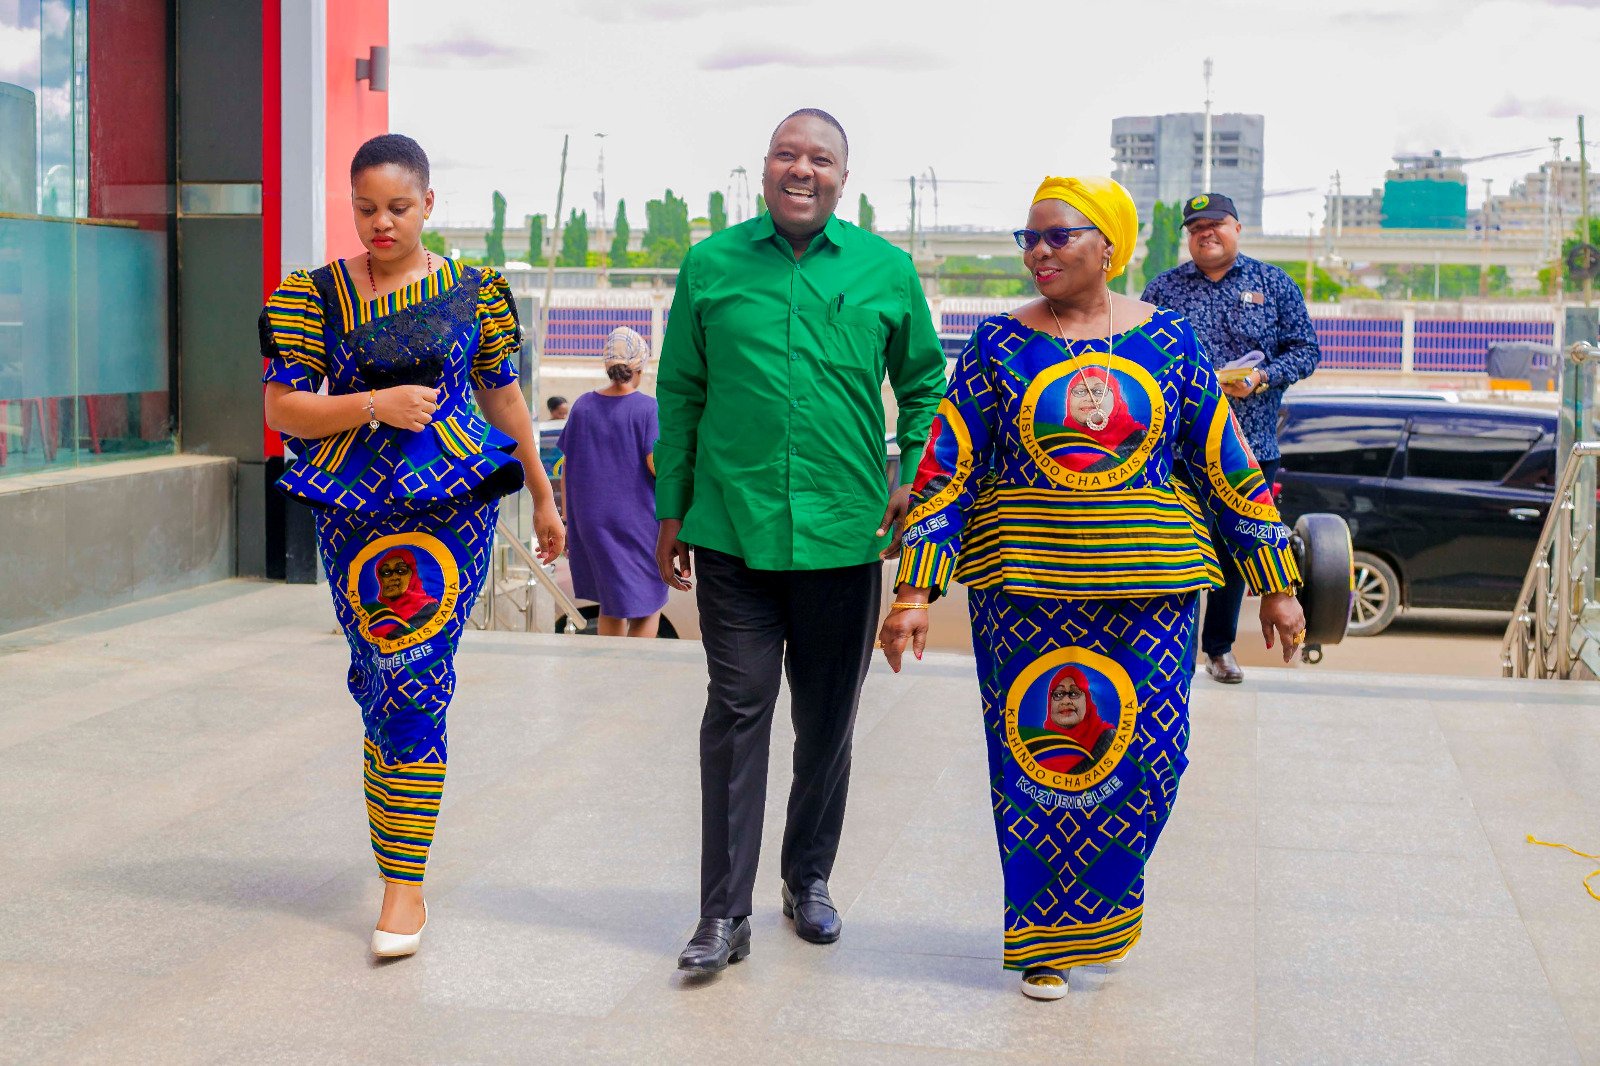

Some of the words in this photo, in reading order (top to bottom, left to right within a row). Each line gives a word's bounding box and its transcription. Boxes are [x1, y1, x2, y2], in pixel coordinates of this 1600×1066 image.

[1021, 405, 1060, 476] KISHINDO
[1065, 473, 1101, 486] CHA
[1107, 457, 1141, 483] RAIS
[1141, 405, 1163, 454] SAMIA
[912, 497, 944, 520] RAIS
[1208, 460, 1263, 516] KISHINDO
[1234, 519, 1273, 539] KAZI
[397, 627, 432, 647] RAIS
[434, 582, 457, 626] SAMIA
[1007, 708, 1046, 780] KISHINDO
[1113, 700, 1135, 753] SAMIA
[1015, 775, 1053, 805] KAZI
